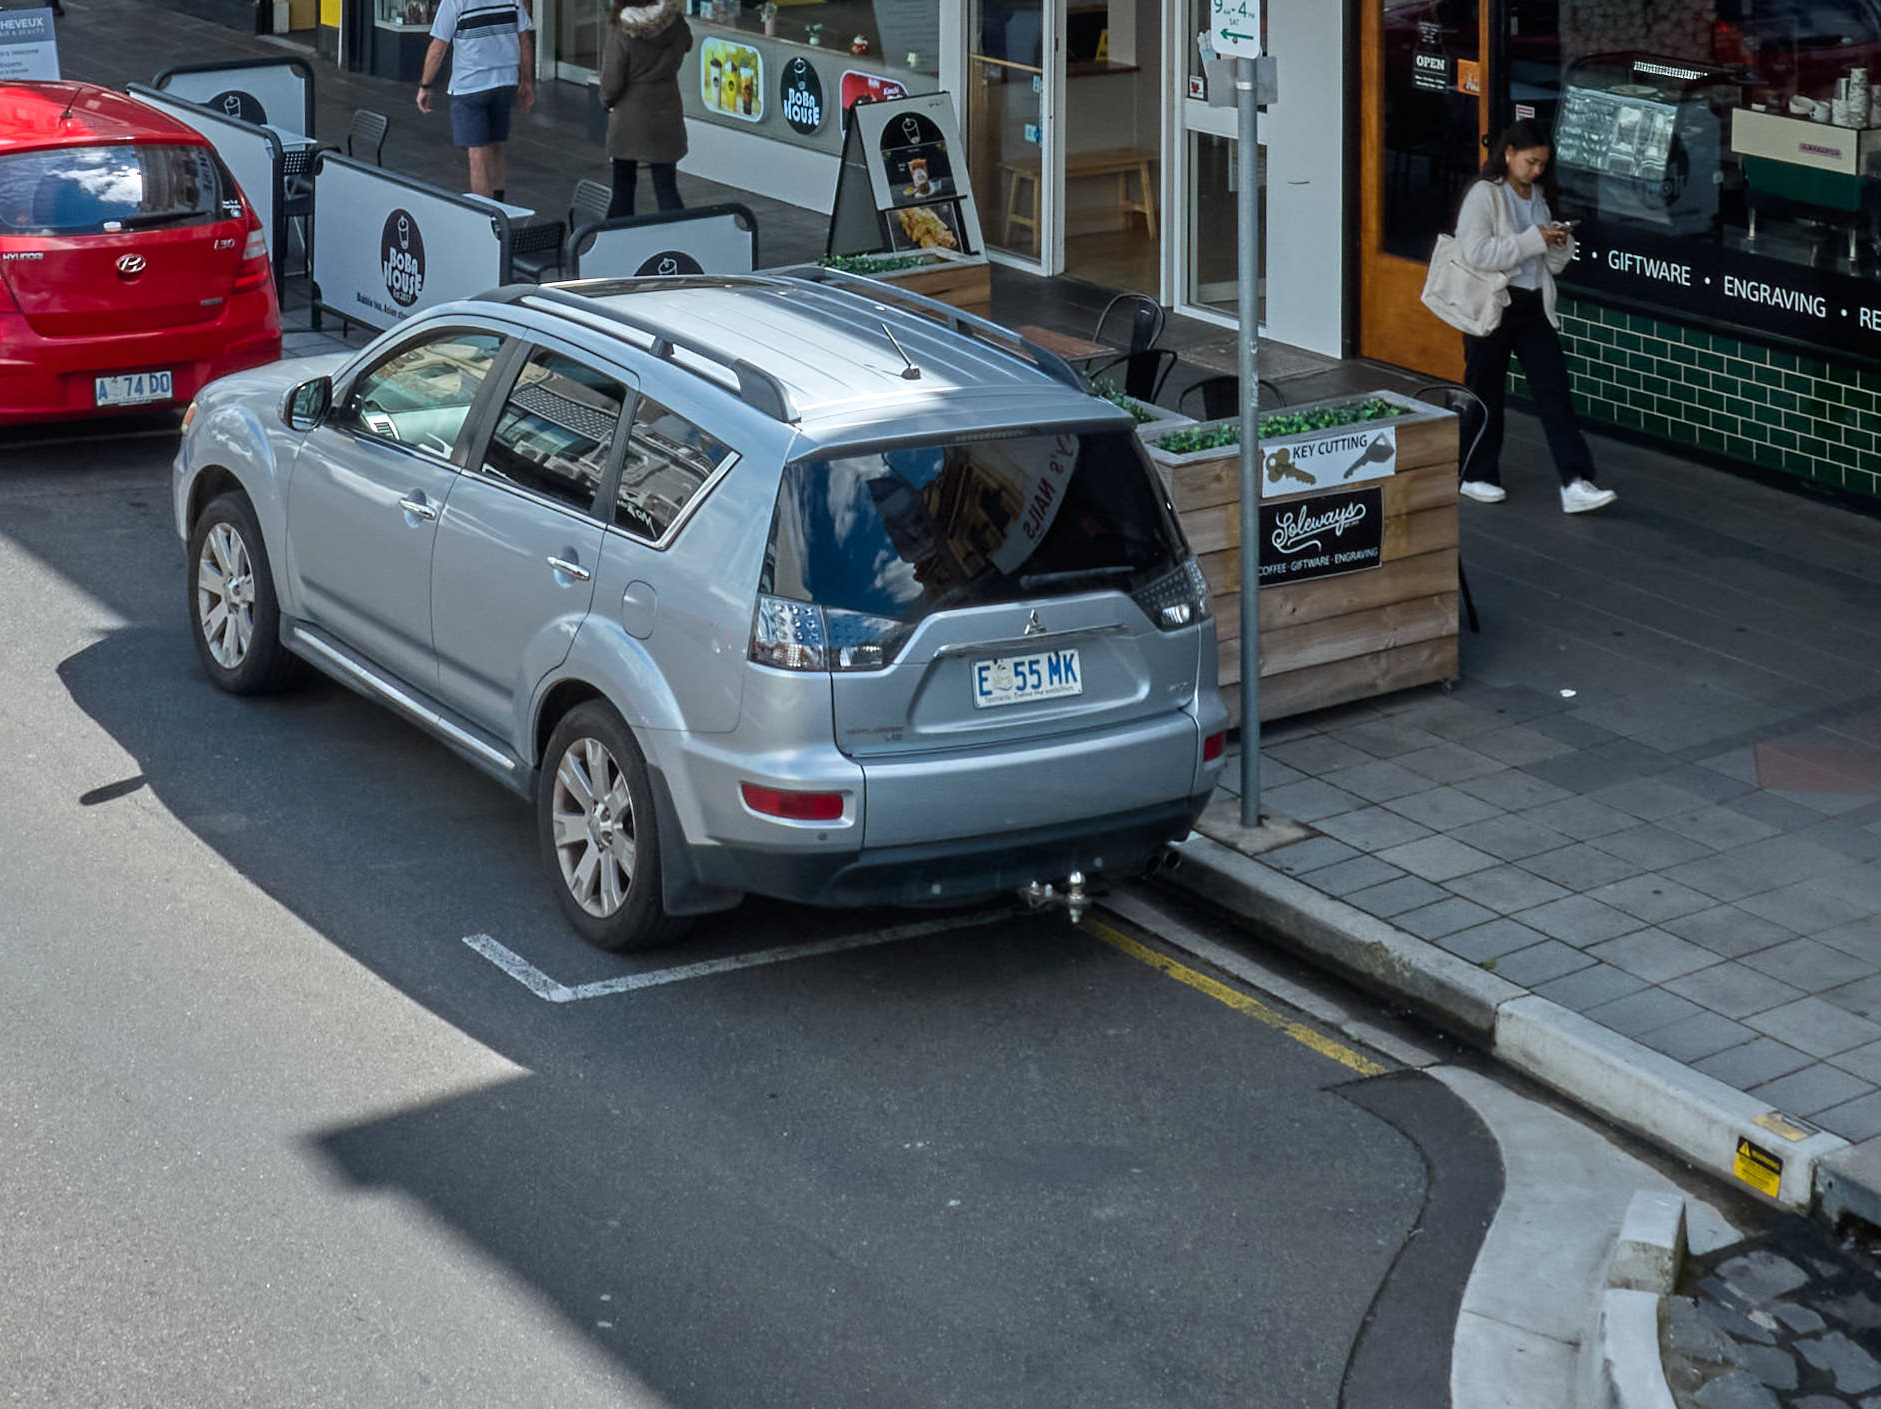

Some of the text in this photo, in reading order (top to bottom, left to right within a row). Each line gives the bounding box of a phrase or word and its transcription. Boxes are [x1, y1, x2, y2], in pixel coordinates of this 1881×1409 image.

[1416, 55, 1446, 71] OPEN
[788, 87, 816, 106] BOBA
[783, 99, 820, 126] HOUSE
[390, 247, 419, 275] BOBA
[383, 260, 423, 296] HOUSE
[1608, 250, 1692, 287] GIFTWARE
[1723, 275, 1827, 319] ENGRAVING
[98, 379, 109, 401] A
[123, 376, 143, 397] 74
[1293, 434, 1368, 459] KEY CUTTING
[1271, 502, 1367, 554] Soleways
[1258, 547, 1379, 577] COFFEE GIFTWARE ENGRAVING
[978, 653, 1078, 696] E 55 MK
